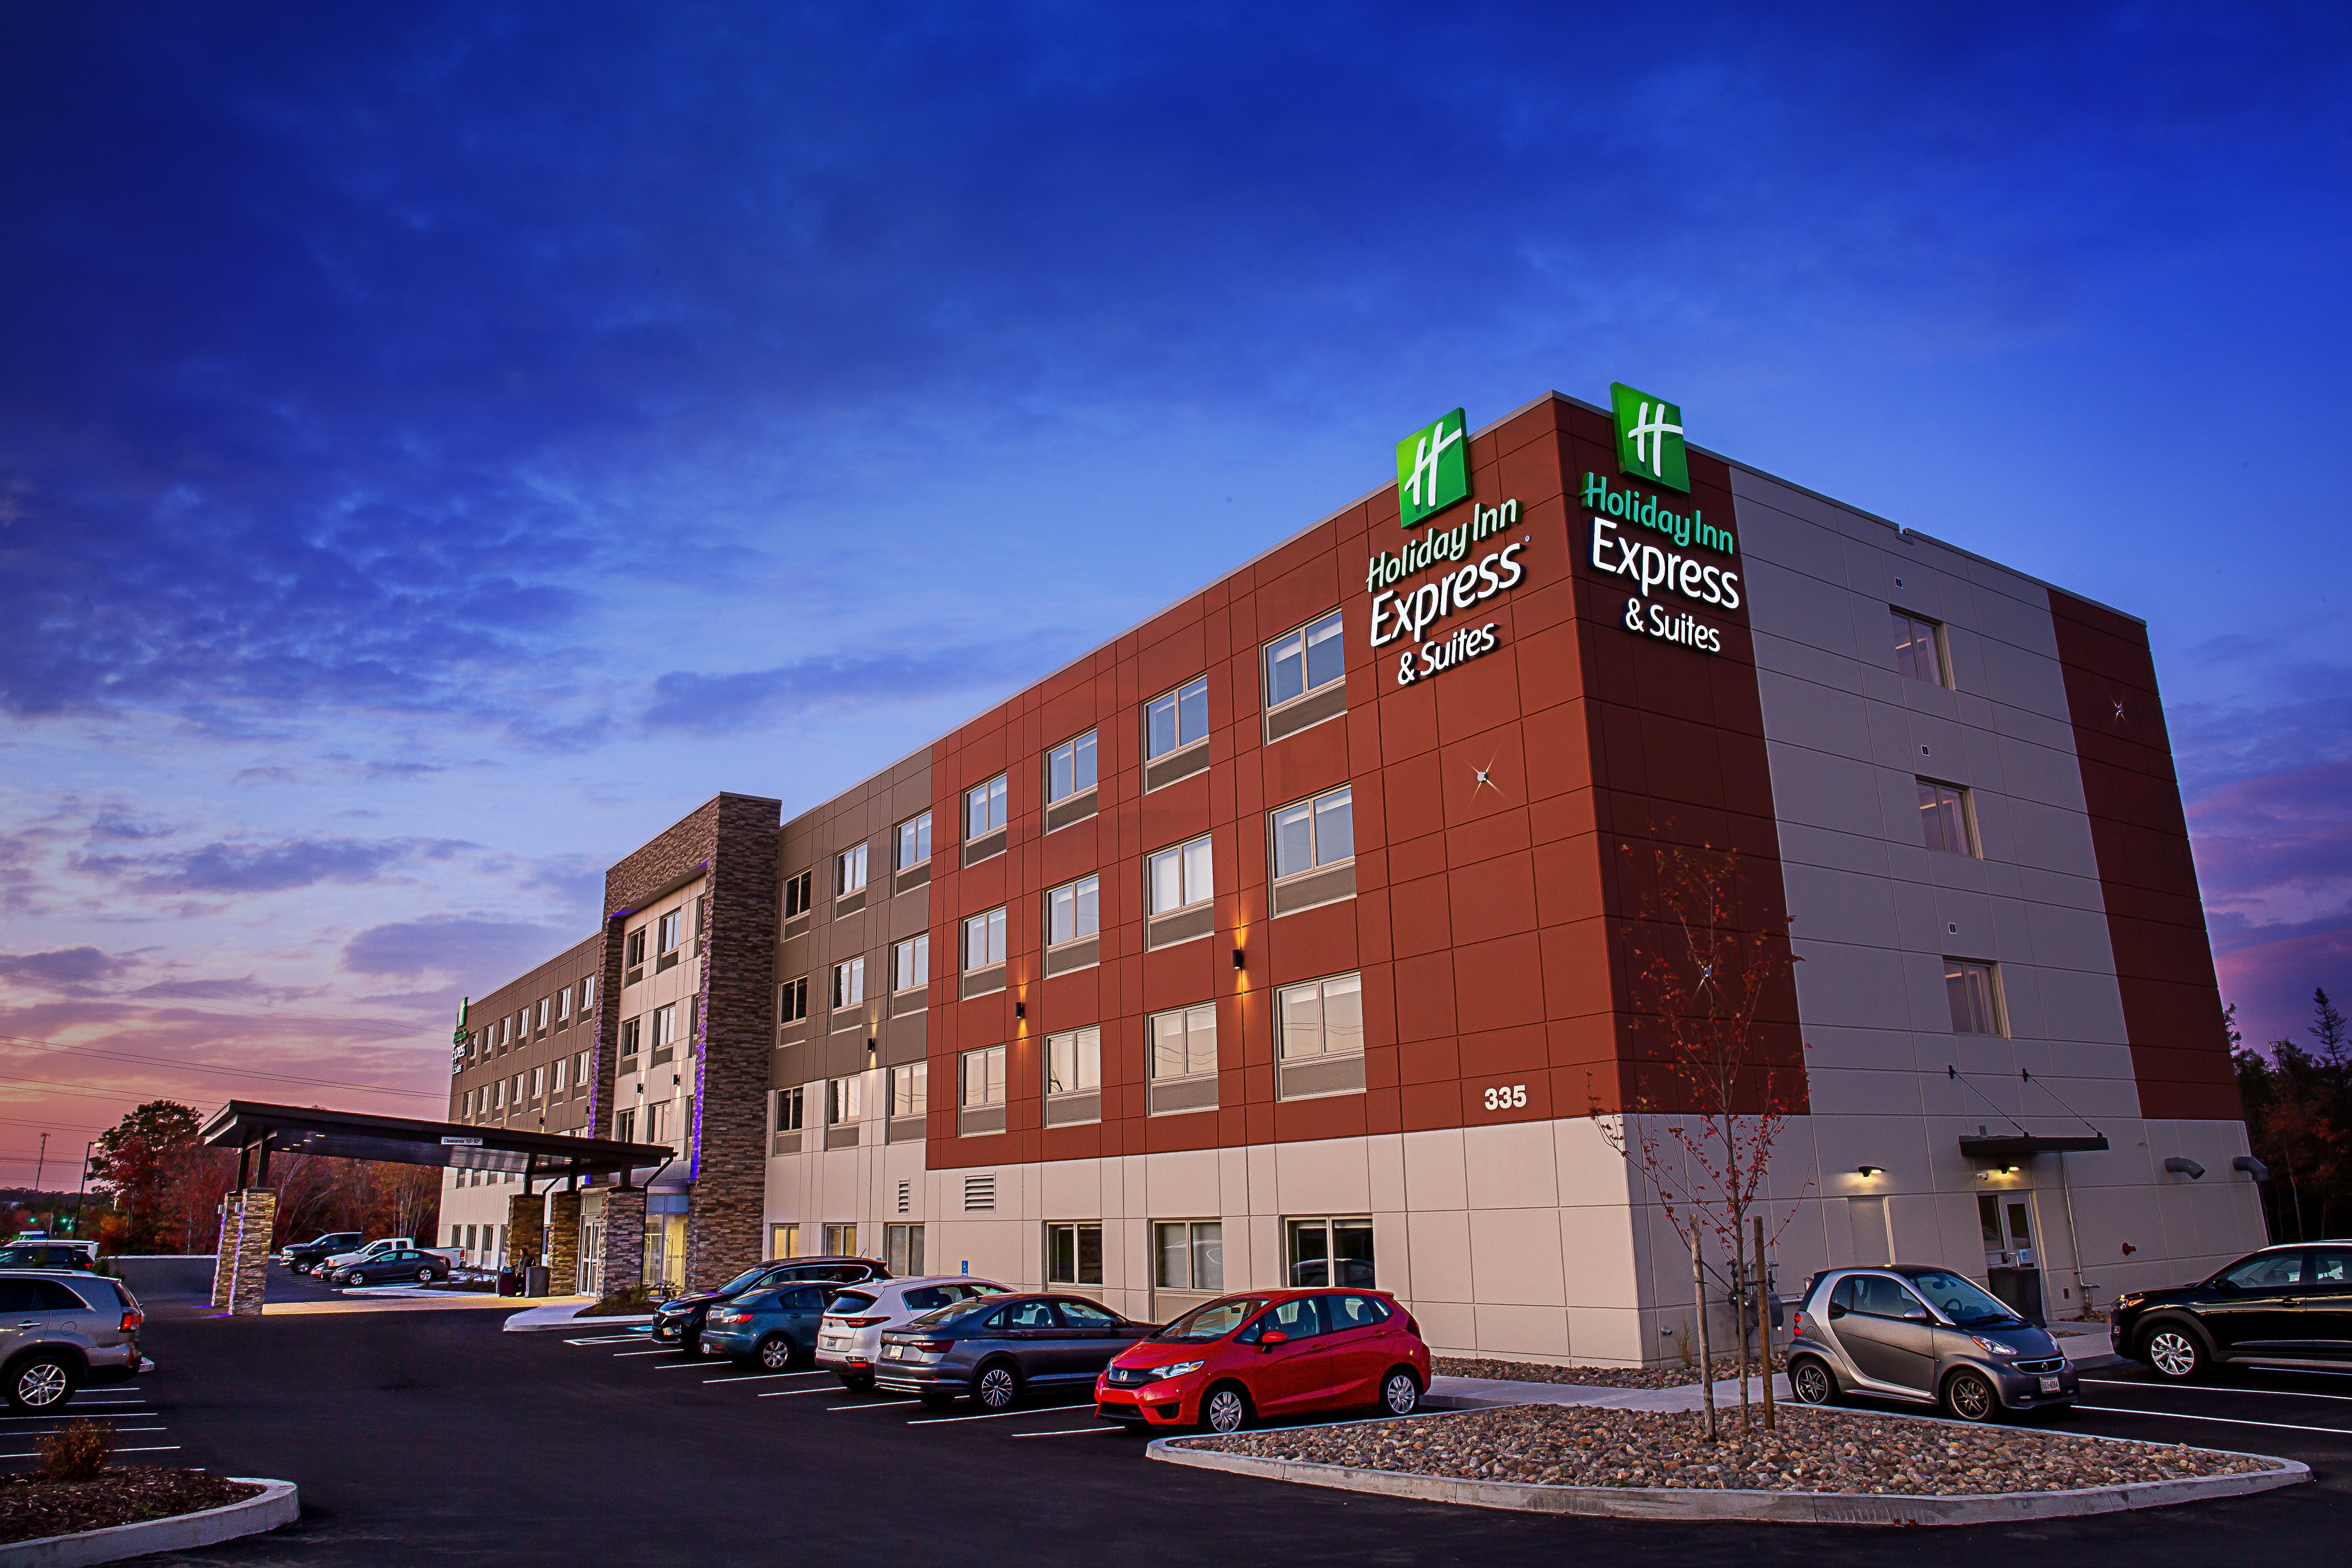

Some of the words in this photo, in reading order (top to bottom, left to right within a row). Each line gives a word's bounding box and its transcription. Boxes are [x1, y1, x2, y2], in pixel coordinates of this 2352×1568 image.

[1366, 522, 1467, 593] Holiday
[1473, 498, 1517, 542] Inn
[1584, 472, 1690, 546] Holiday
[1696, 510, 1733, 554] Inn
[1370, 543, 1521, 647] Express
[1592, 517, 1740, 609] Express
[1397, 651, 1415, 685] &
[1420, 623, 1494, 676] Suites
[1626, 597, 1645, 632] &
[1650, 604, 1721, 652] Suites
[1484, 1084, 1527, 1111] 335
